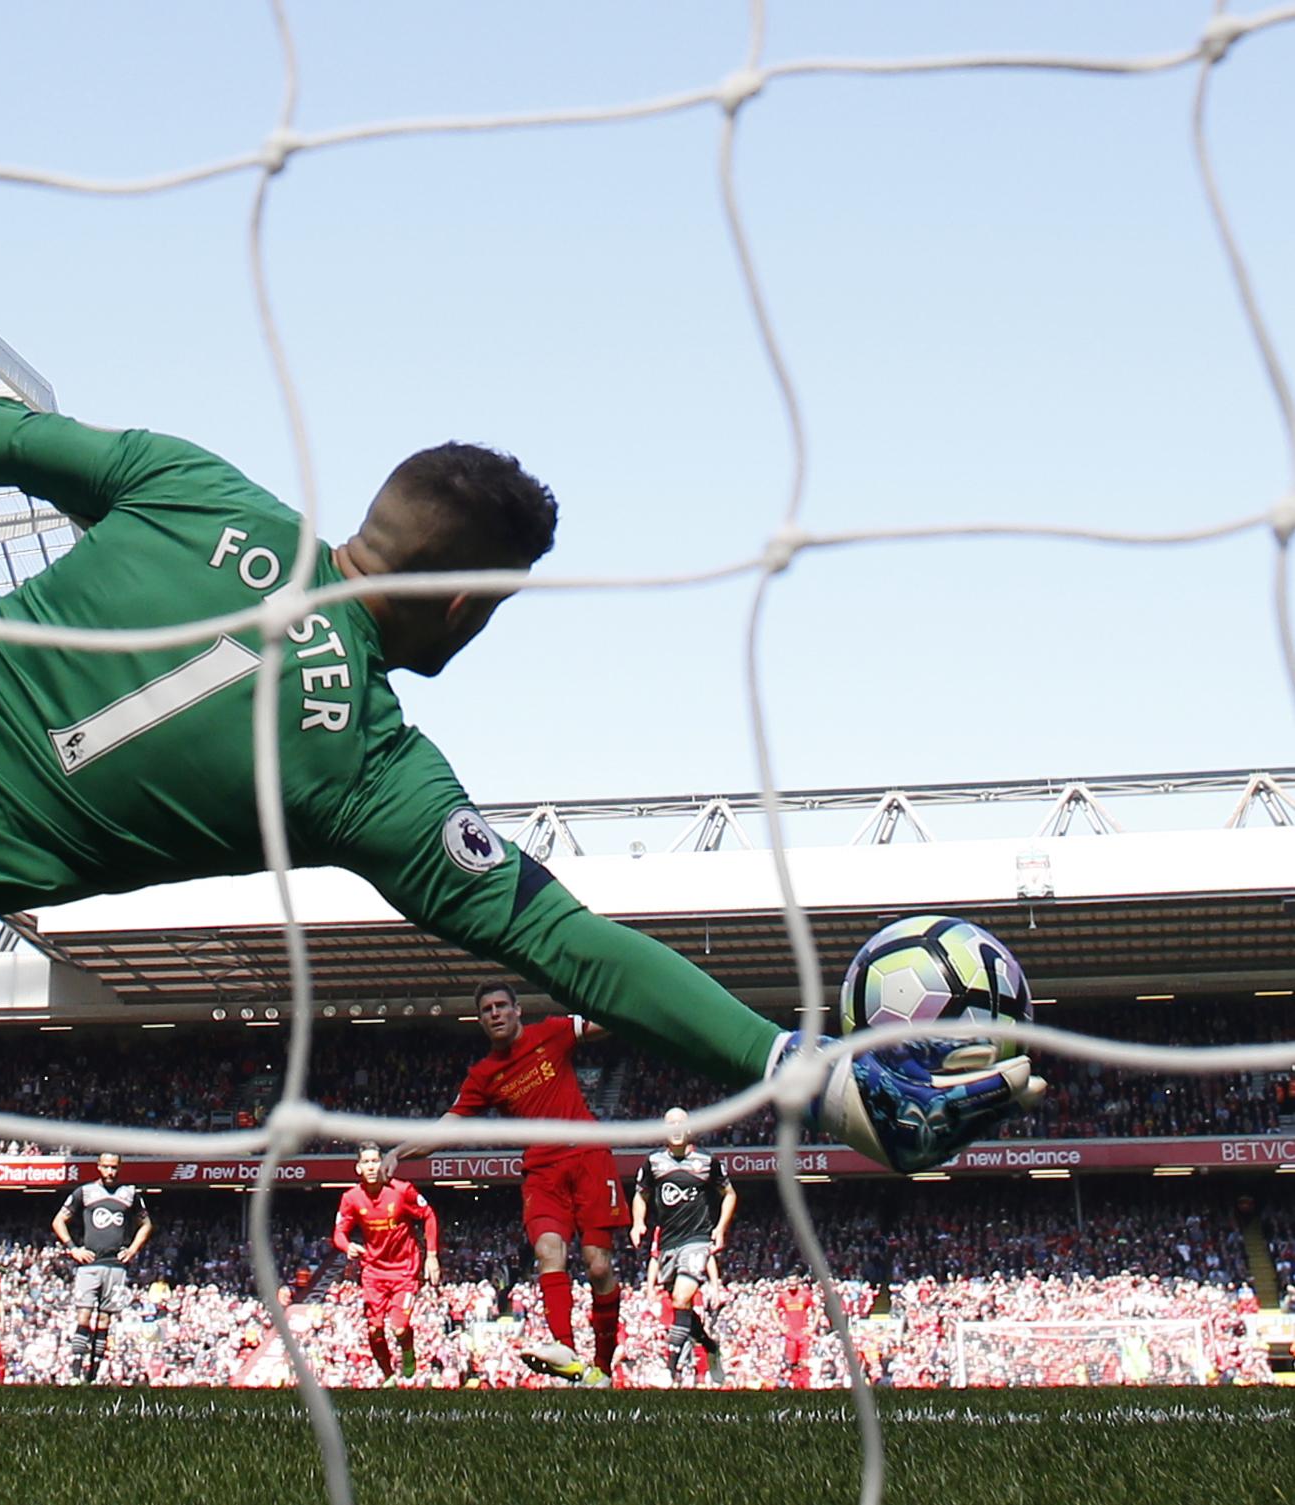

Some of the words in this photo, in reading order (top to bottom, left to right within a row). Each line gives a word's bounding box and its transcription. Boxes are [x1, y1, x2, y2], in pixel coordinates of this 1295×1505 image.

[208, 526, 352, 732] FOSTER
[48, 634, 264, 776] 1
[508, 1076, 543, 1100] artered
[731, 1154, 814, 1172] Charted
[966, 1152, 1003, 1166] new
[1005, 1149, 1081, 1165] balance
[202, 1165, 237, 1180] new
[238, 1163, 306, 1180] balnce
[430, 1158, 524, 1177] BETVICTO
